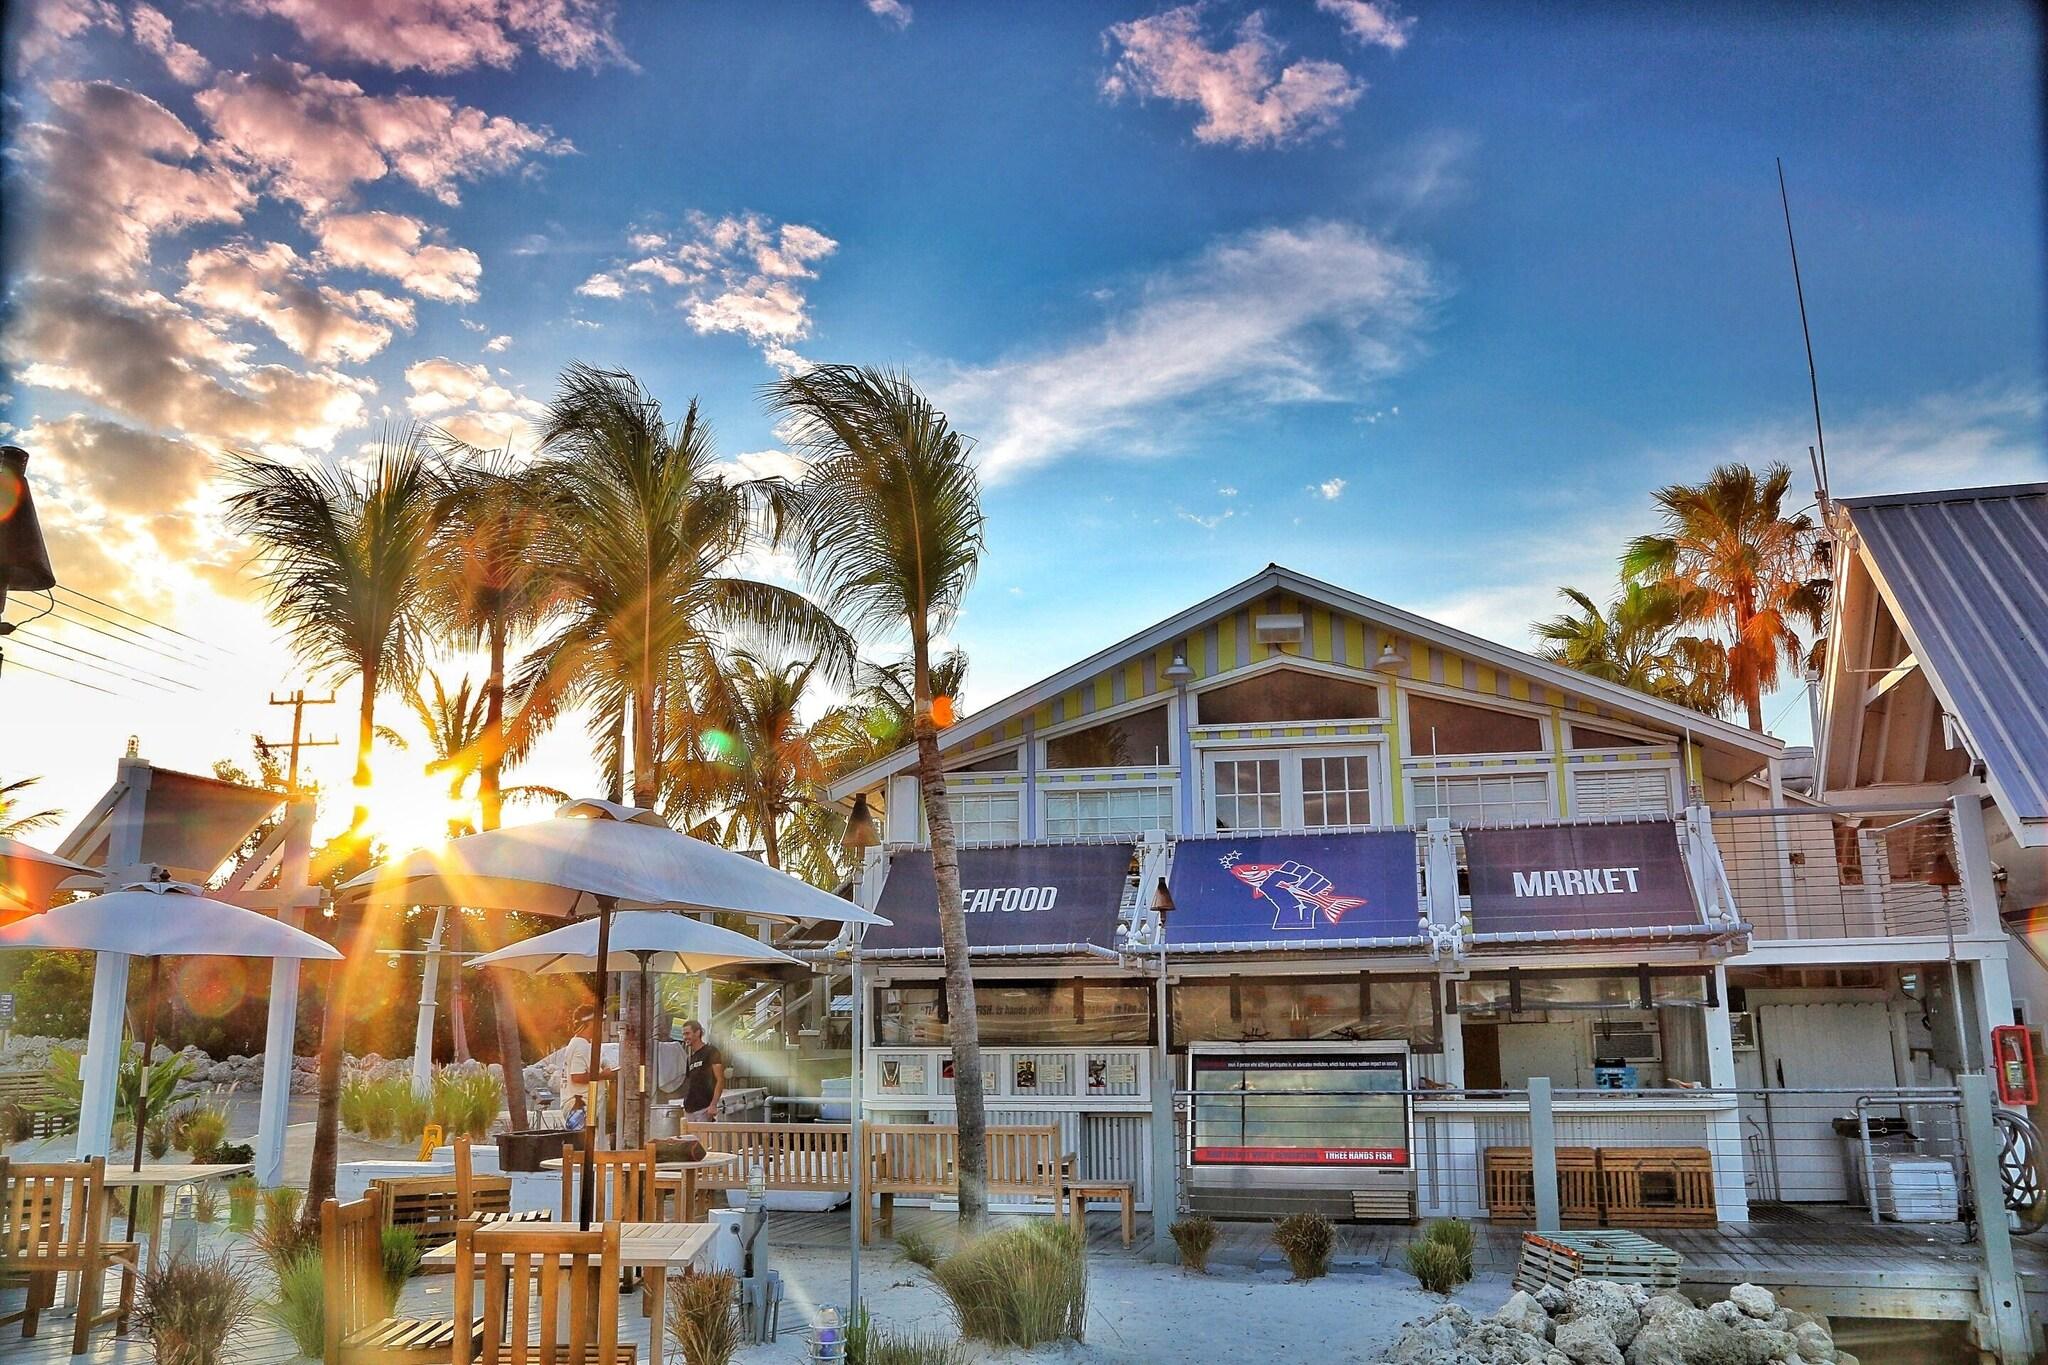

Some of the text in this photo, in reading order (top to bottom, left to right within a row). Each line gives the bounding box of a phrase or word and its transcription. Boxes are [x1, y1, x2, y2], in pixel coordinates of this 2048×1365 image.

[1513, 867, 1640, 898] MARKET
[960, 886, 1058, 913] EAFOOD
[1325, 1151, 1347, 1160] THREE
[1348, 1151, 1374, 1160] HANDS
